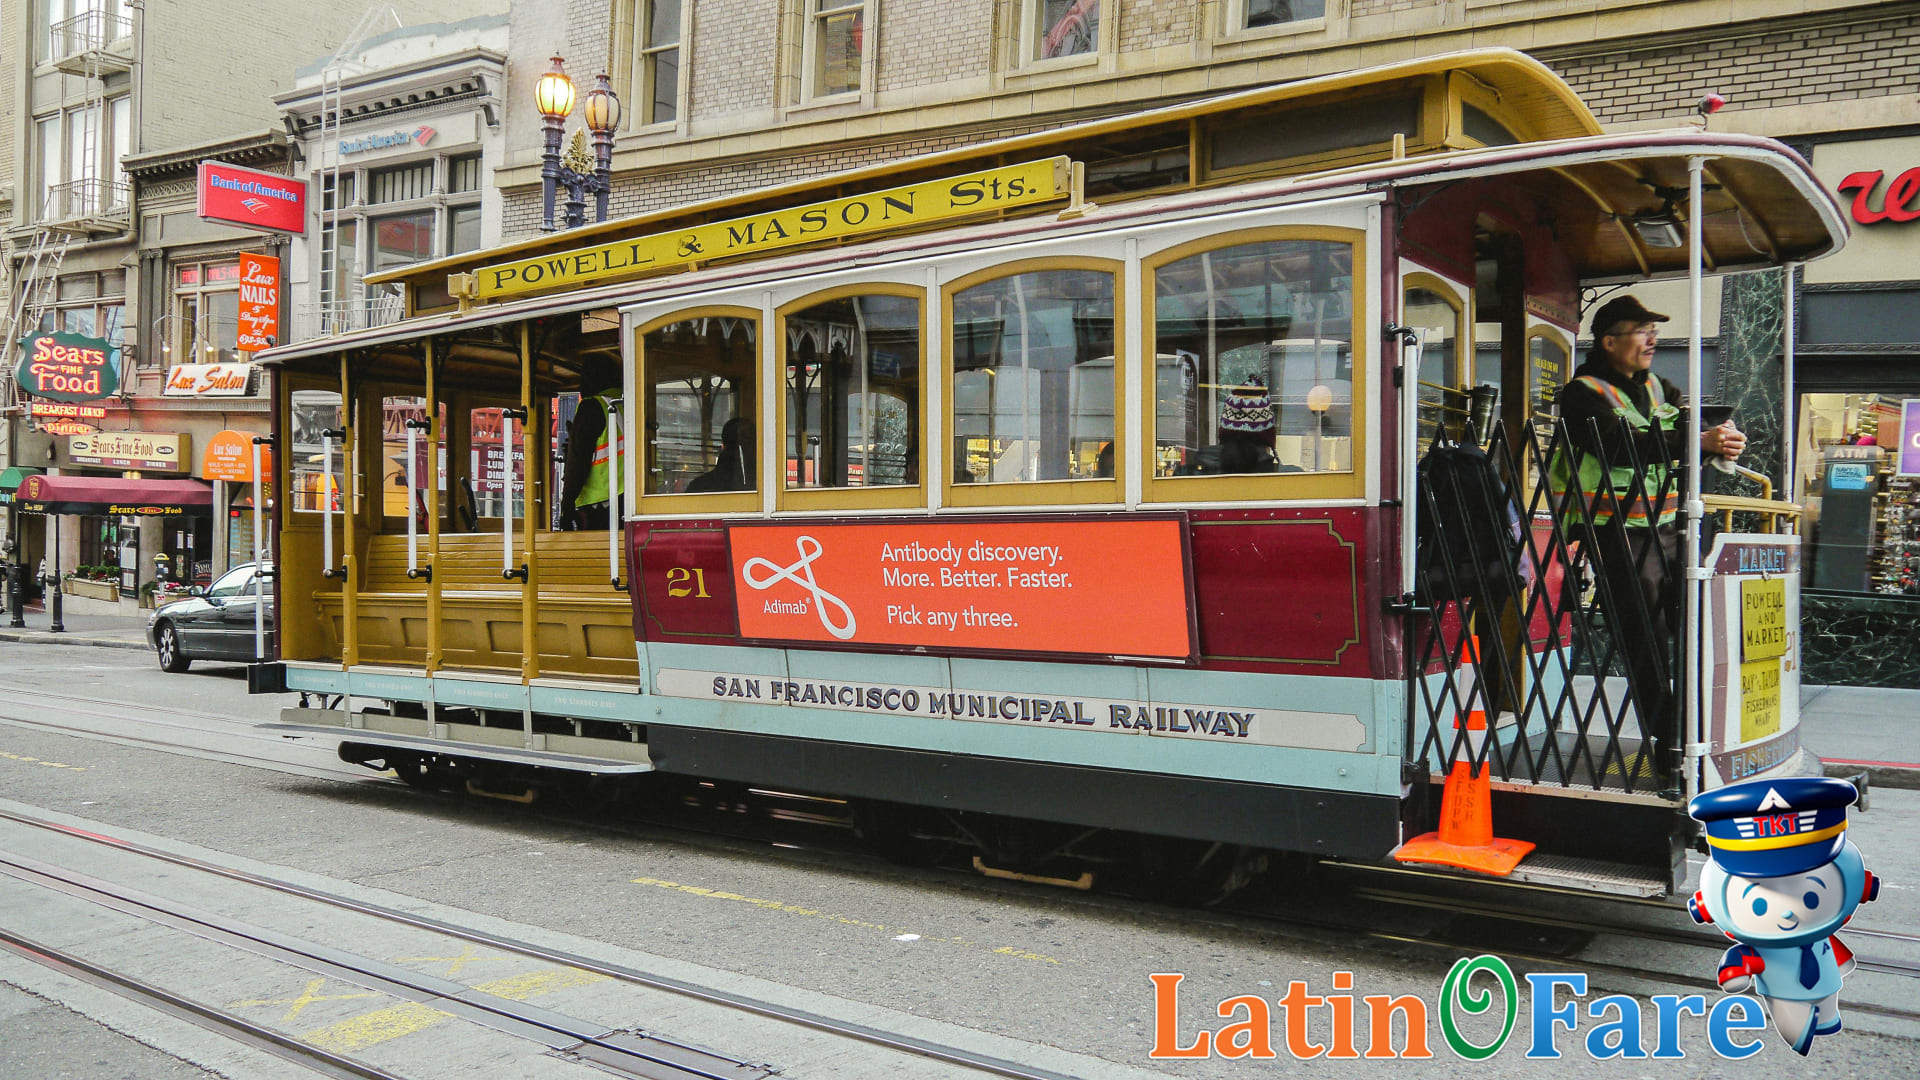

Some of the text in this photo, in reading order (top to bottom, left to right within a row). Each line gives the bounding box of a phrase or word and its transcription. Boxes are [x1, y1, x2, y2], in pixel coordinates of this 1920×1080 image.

[211, 174, 298, 202] Bank of America
[493, 176, 1037, 290] POWELL & MASON Sts.
[242, 261, 275, 285] Lux
[241, 284, 276, 305] NAILS
[32, 337, 105, 365] Sears
[30, 363, 101, 394] Food
[60, 365, 83, 374] FINE
[167, 366, 245, 393] Lux Salon
[32, 403, 105, 417] BREAKFAST LUNCH
[47, 423, 90, 434] Dinner
[90, 434, 153, 457] Sears Fine Food
[214, 443, 242, 455] Lux Salon
[1833, 448, 1868, 459] ATM
[486, 481, 503, 490] Open
[109, 505, 136, 514] Sears
[881, 540, 1063, 567] Antibody discovery.
[1739, 548, 1786, 572] MARKET
[666, 568, 712, 598] 21
[883, 567, 1073, 588] More. Better. Faster.
[1746, 592, 1783, 611] POWELL
[887, 604, 1018, 631] Pick any three.
[1758, 612, 1776, 625] AND
[1746, 627, 1785, 647] MARKET
[712, 676, 1256, 738] SAN FRANCISCO MUNICIPAL RAILWAY
